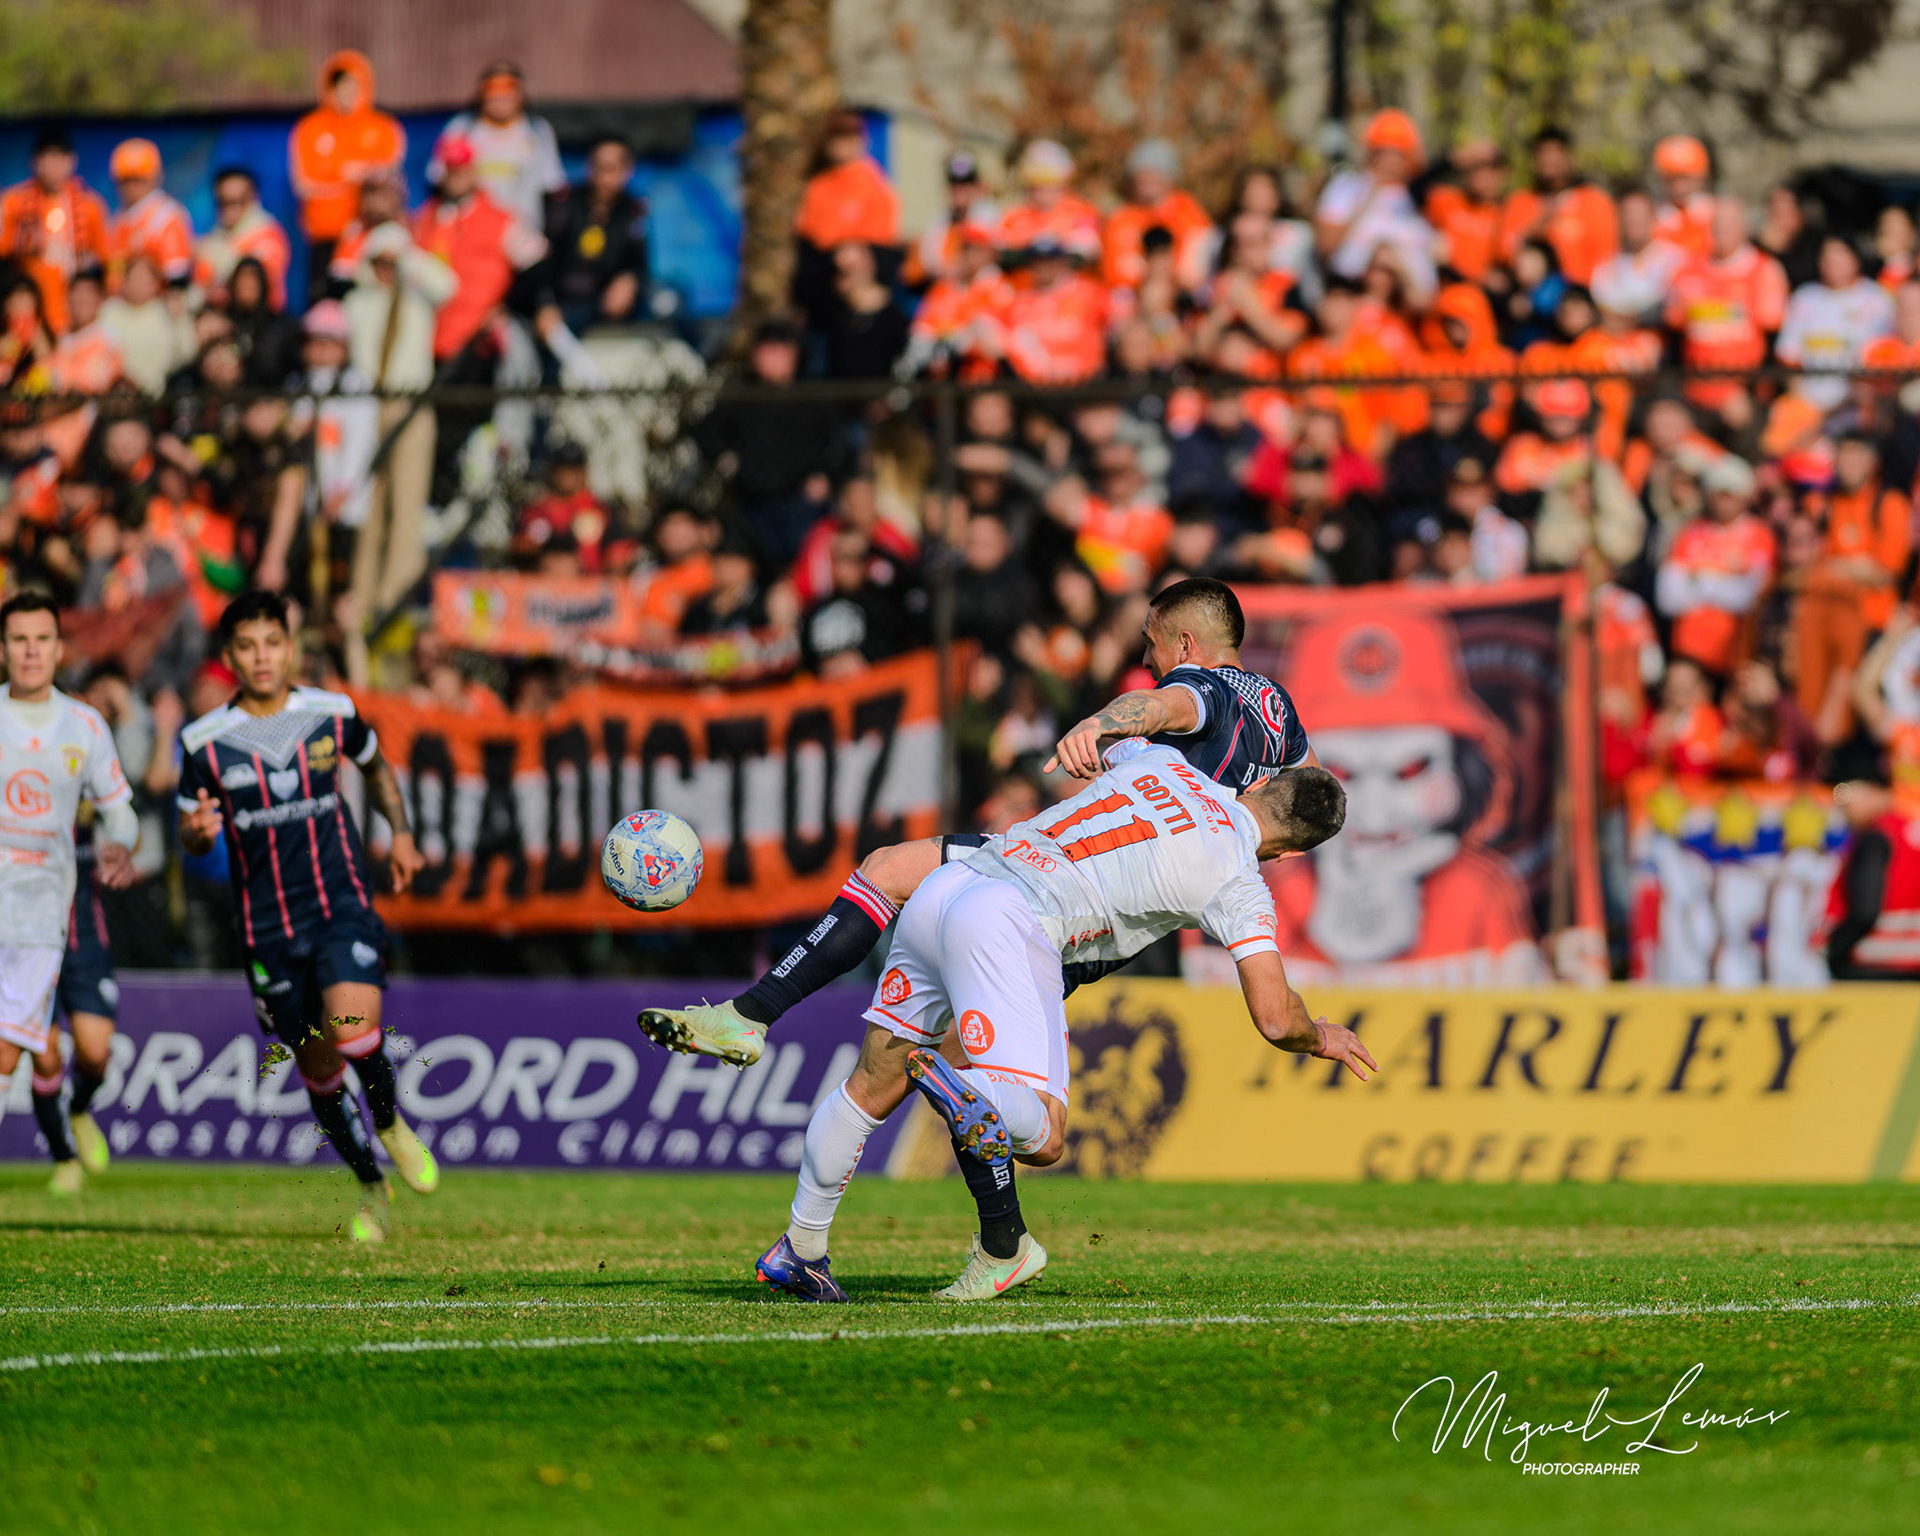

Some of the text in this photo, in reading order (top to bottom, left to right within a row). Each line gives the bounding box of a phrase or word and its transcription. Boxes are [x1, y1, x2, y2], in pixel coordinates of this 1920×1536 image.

[1035, 788, 1158, 863] 11
[1132, 774, 1197, 836] GOTTI
[608, 838, 635, 876] molten
[771, 913, 839, 978] DEPORTES RECOLETA
[46, 1030, 638, 1122] BRADORD
[1246, 1006, 1842, 1096] MARLEY
[1358, 1130, 1648, 1182] COFFEE
